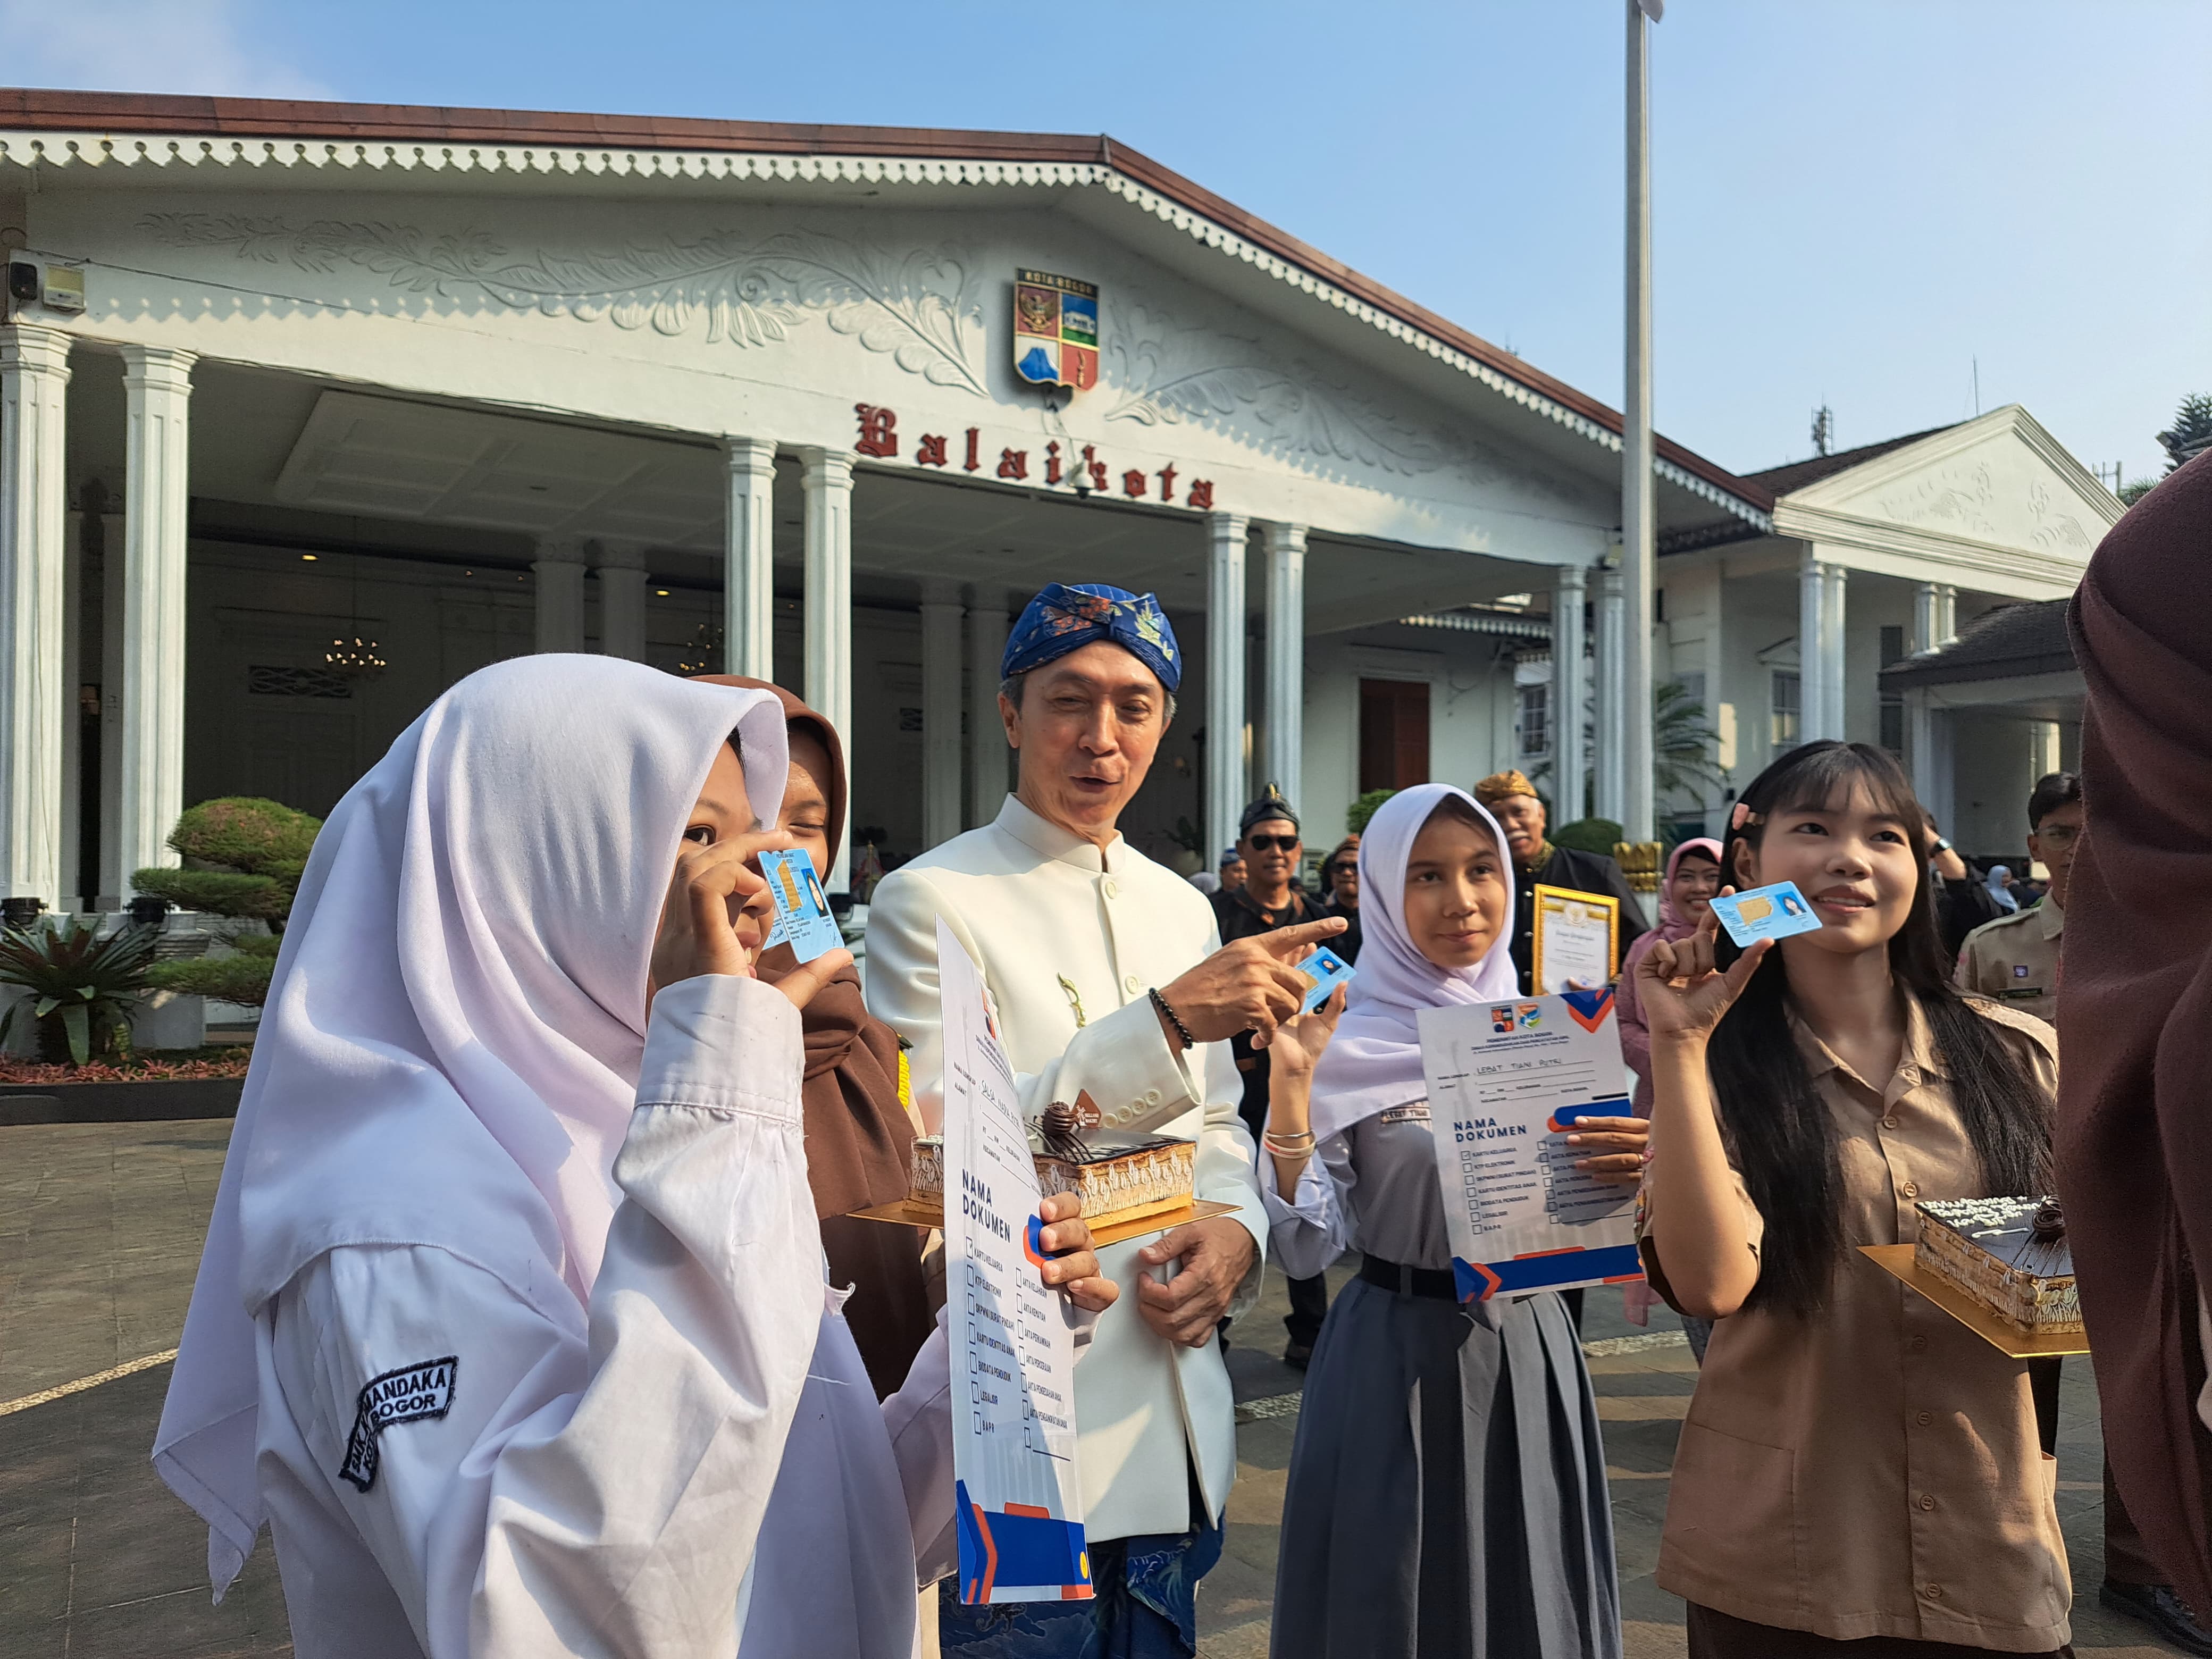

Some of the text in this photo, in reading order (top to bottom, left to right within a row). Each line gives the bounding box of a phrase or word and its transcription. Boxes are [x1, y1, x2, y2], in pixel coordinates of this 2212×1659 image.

[1453, 1117, 1497, 1132] NAMA
[1455, 1124, 1527, 1143] DOKUMEN
[962, 1168, 992, 1208] NAMA
[962, 1193, 1011, 1243] DOKUMEN
[371, 1393, 437, 1426] BOGOR
